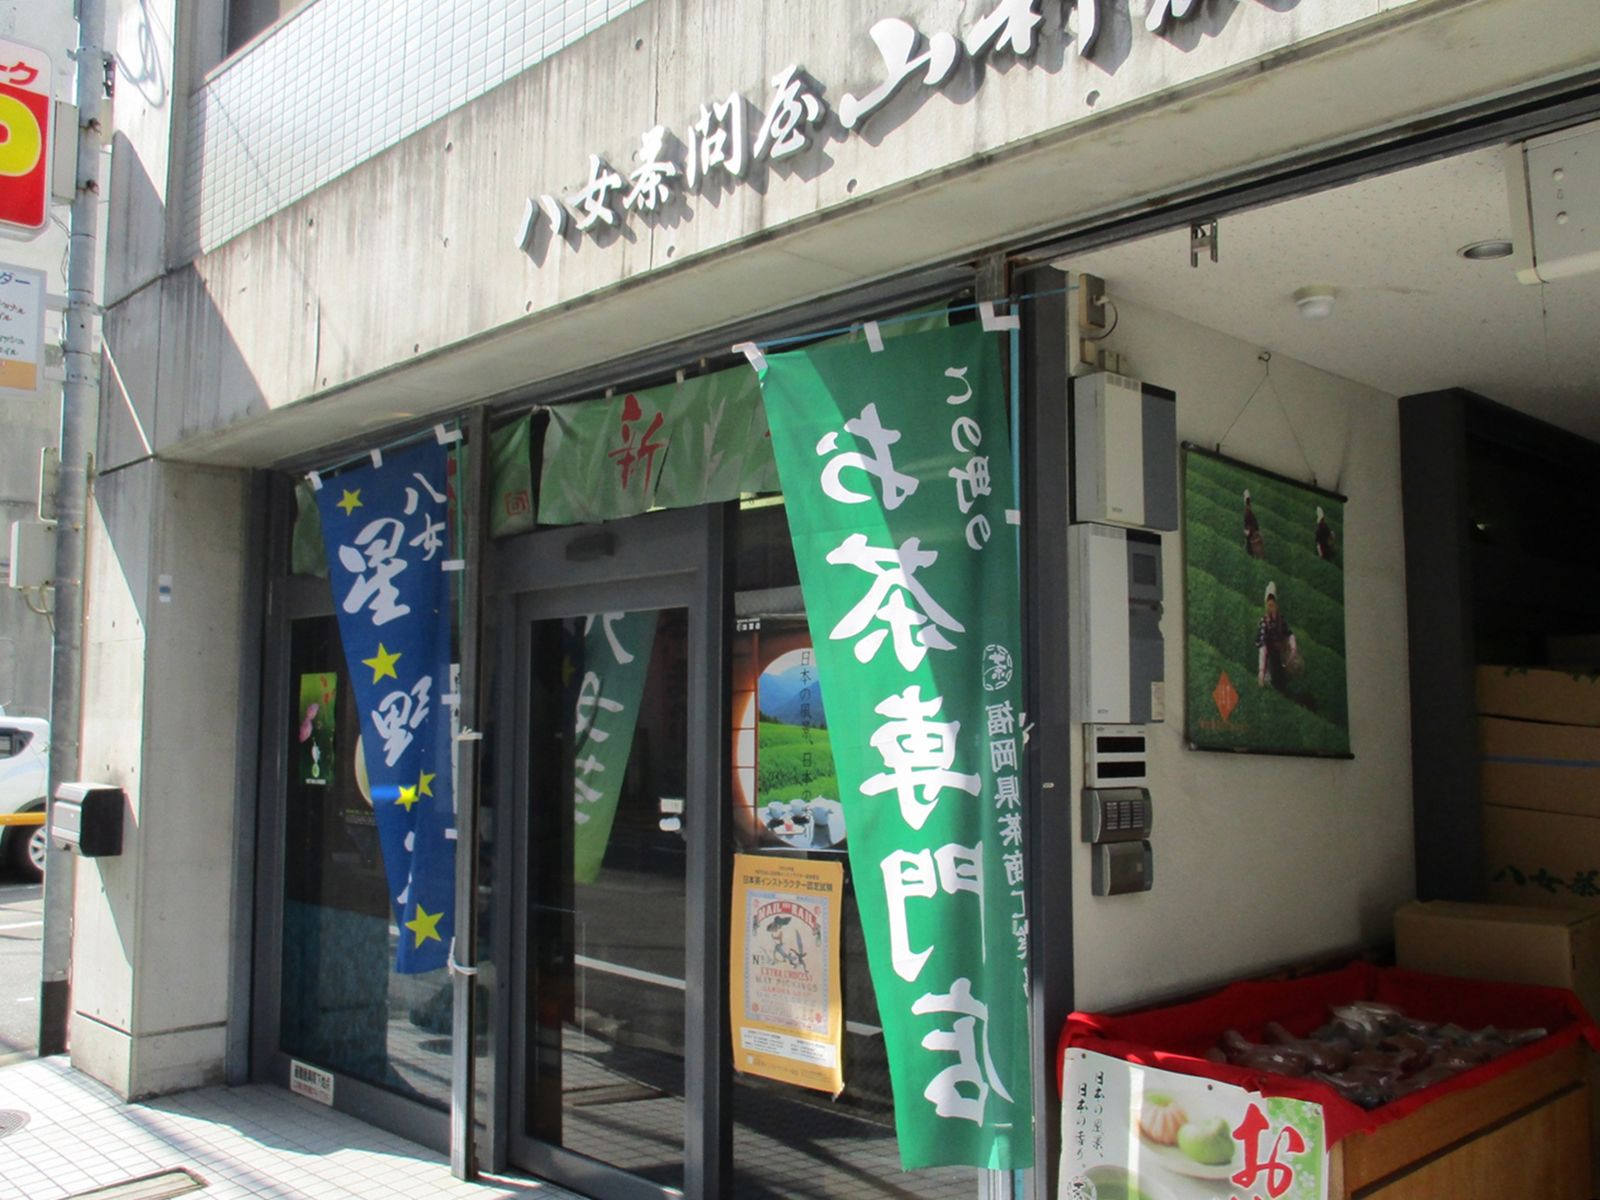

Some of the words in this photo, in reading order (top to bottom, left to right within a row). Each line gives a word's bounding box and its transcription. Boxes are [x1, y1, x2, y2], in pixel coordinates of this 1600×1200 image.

[514, 65, 820, 250] 八女茶問屋
[403, 472, 448, 561] 八女
[338, 517, 432, 904] 星野
